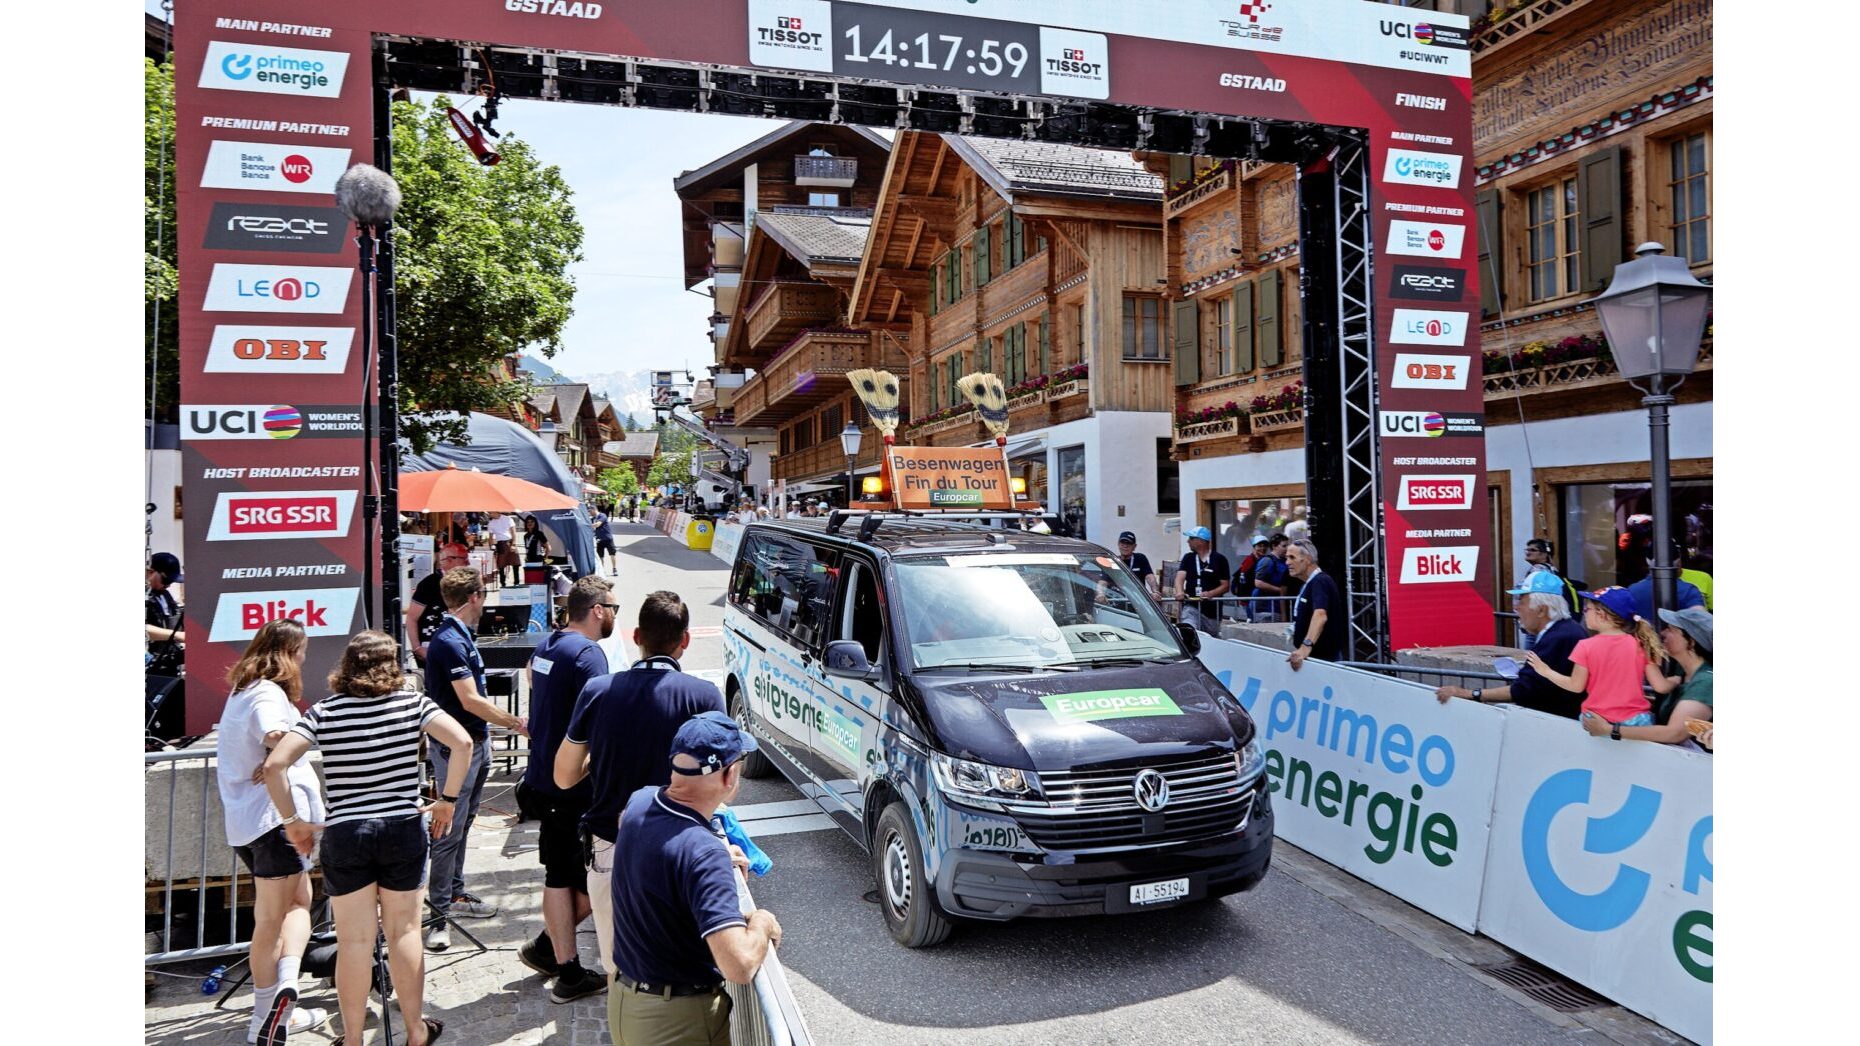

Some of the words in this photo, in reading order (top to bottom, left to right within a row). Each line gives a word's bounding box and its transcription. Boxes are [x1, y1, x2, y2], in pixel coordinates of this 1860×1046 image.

[505, 0, 602, 20] GSTAAD
[216, 18, 258, 32] MAIN
[260, 20, 332, 38] PARTNER
[758, 28, 822, 46] TISSOT
[1380, 20, 1411, 39] UCI
[844, 24, 1028, 78] 14:17:59
[1400, 50, 1448, 64] #UCIWWT
[256, 55, 324, 74] primeo
[1046, 58, 1101, 75] TISSOT
[256, 70, 328, 90] energie
[1220, 72, 1286, 93] GSTAAD
[1395, 92, 1446, 111] FINISH
[201, 116, 276, 132] PREMIUM
[279, 122, 350, 136] PARTNER
[1390, 132, 1414, 141] MAIN
[1414, 133, 1453, 146] PARTNER
[1414, 158, 1449, 170] primeo
[1414, 168, 1452, 182] energie
[1385, 202, 1425, 214] PREMIUM
[1426, 204, 1464, 216] PARTNER
[233, 338, 328, 360] OBI
[1406, 363, 1456, 380] OBI
[190, 410, 256, 434] UCI
[308, 413, 360, 421] WOMEN'S
[1386, 416, 1420, 432] UCI
[894, 456, 1004, 474] Besenwagen
[1393, 457, 1416, 466] HOST
[1416, 457, 1477, 466] BROADCASTER
[204, 468, 246, 479] HOST
[249, 466, 360, 478] BROADCASTER
[905, 475, 930, 490] Fin
[936, 475, 956, 490] du
[960, 475, 998, 490] Tour
[934, 492, 978, 503] Europcar
[1410, 486, 1436, 499] SRG
[1438, 486, 1462, 499] SSR
[235, 506, 282, 526] SRG
[287, 505, 332, 524] SSR
[1405, 529, 1432, 538] MEDIA
[1434, 528, 1472, 538] PARTNER
[222, 566, 273, 579] MEDIA
[275, 564, 346, 577] PARTNER
[1416, 554, 1462, 576] Blick
[242, 600, 328, 630] Blick
[1056, 694, 1162, 714] Europcar
[823, 712, 858, 749] Europcar
[1266, 685, 1456, 788] primeo
[1265, 749, 1458, 868] energie
[1154, 880, 1184, 898] 55194
